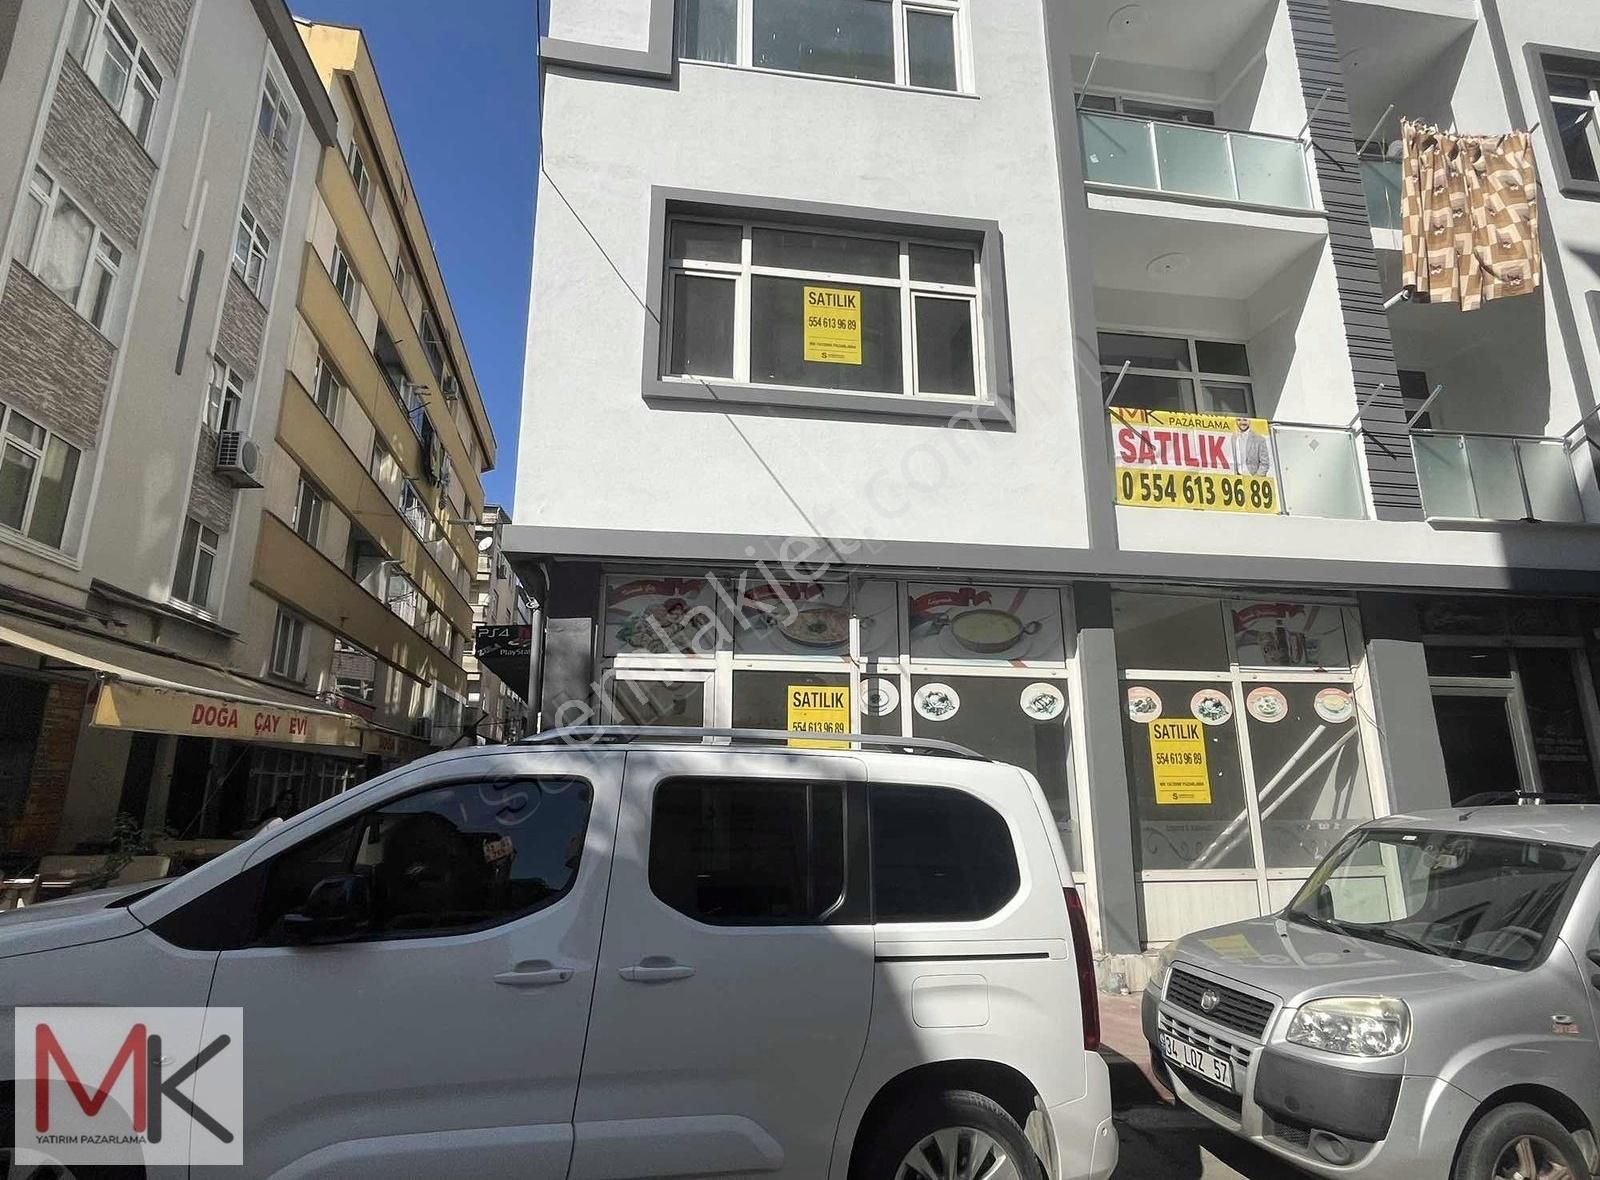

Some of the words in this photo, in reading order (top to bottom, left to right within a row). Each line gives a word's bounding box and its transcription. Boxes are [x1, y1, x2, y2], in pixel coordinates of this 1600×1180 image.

[809, 292, 856, 308] SATILIK
[809, 316, 822, 328] 554
[823, 318, 836, 329] 613
[837, 319, 846, 330] 96
[848, 320, 857, 330] 89
[1169, 417, 1230, 430] PAZARLAMA
[1118, 428, 1230, 470] SATILIK
[1122, 471, 1134, 501] 0
[1140, 473, 1177, 502] 554
[1182, 475, 1216, 505] 613
[1221, 478, 1246, 507] 96
[1250, 480, 1273, 509] 89
[478, 628, 510, 638] PS4
[500, 648, 531, 657] PlaySta
[793, 691, 844, 708] SATILIK
[191, 703, 239, 729] DOĞA
[254, 712, 281, 736] ÇAY
[288, 717, 308, 736] EVİ
[1153, 723, 1200, 740] SATILIK
[1156, 752, 1169, 765] 554
[1170, 752, 1183, 765] 613
[1183, 752, 1193, 765] 96
[1193, 752, 1203, 765] 89
[1165, 1036, 1178, 1058] 34
[1183, 1045, 1205, 1072] LOZ
[1213, 1057, 1227, 1082] 57
